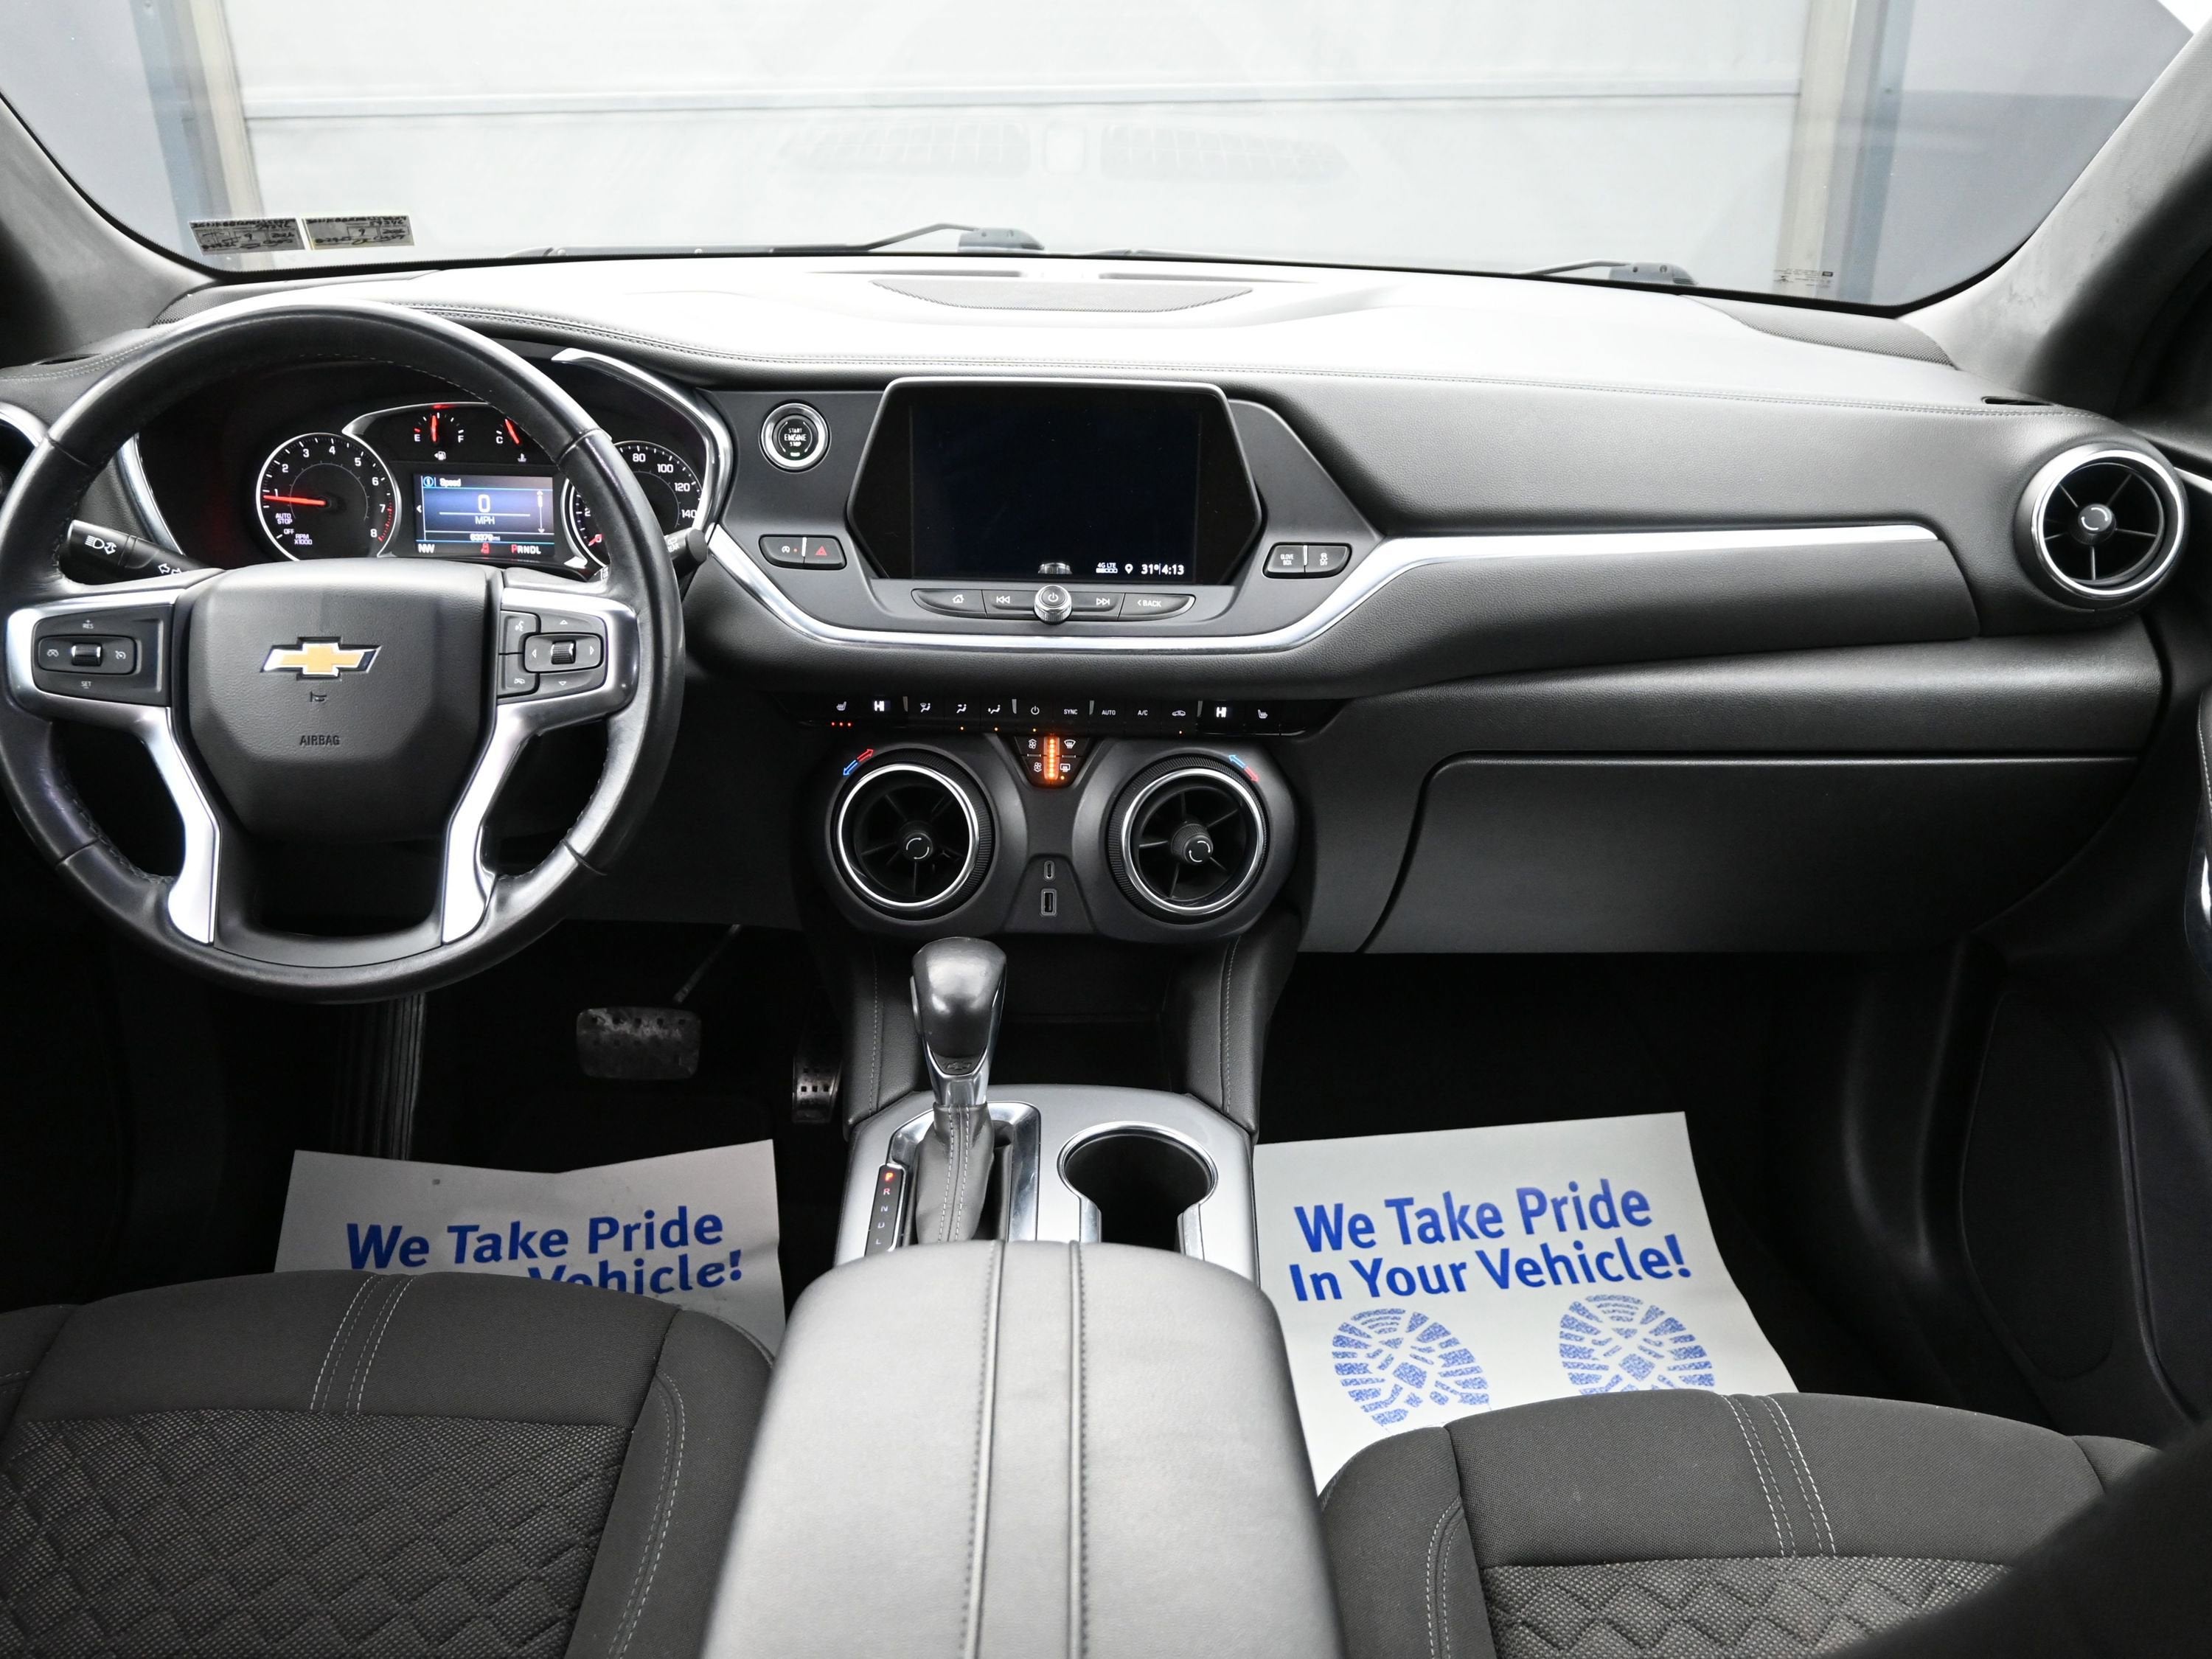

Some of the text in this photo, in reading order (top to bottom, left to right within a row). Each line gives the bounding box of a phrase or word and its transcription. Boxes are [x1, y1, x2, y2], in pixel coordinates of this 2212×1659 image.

[495, 436, 503, 444] C
[303, 448, 310, 457] 3
[329, 446, 335, 454] 4
[355, 457, 361, 466] 5
[632, 453, 646, 462] 80
[282, 464, 288, 473] 2
[657, 464, 673, 473] 100
[372, 476, 379, 486] 6
[674, 482, 690, 492] 120
[478, 494, 491, 512] 0
[379, 504, 386, 513] 7
[681, 509, 698, 518] 140
[475, 516, 495, 525] MPH
[370, 528, 377, 538] 8
[418, 543, 435, 553] NW
[511, 544, 541, 554] PRNDL
[1161, 564, 1185, 575] 4:13
[1142, 599, 1162, 608] BACK
[874, 700, 885, 712] HI
[1216, 706, 1227, 718] HI
[299, 734, 340, 746] AIRBAG
[885, 1172, 894, 1181] P
[1294, 1178, 1652, 1253] We Take Pride
[346, 1205, 723, 1270] We Take Pride
[1289, 1234, 1692, 1302] In Your Vehicle!
